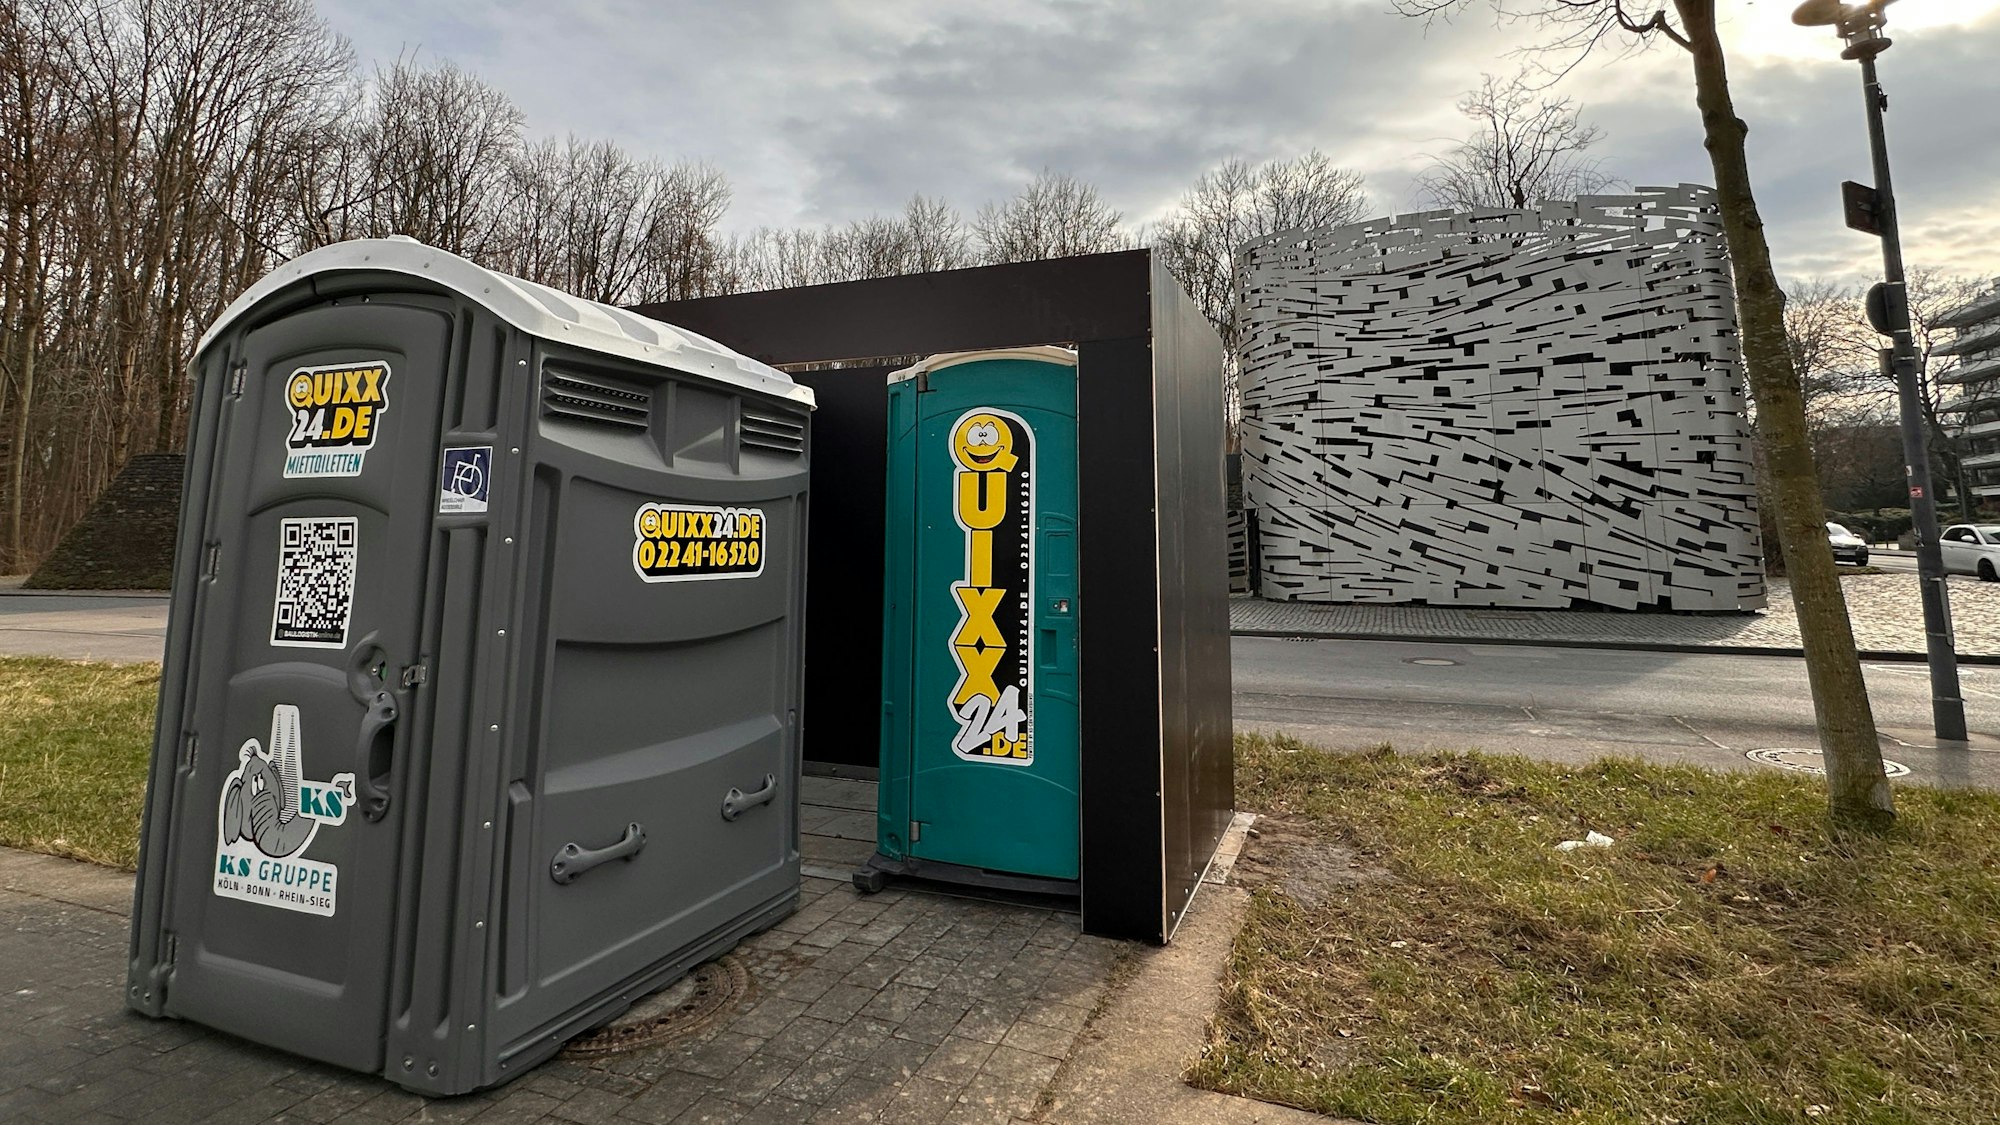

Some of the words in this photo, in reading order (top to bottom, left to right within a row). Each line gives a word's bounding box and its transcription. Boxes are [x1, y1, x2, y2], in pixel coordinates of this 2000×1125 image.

[291, 369, 382, 408] QUIXX
[291, 406, 372, 441] 24.DE
[286, 453, 363, 475] MIETTOILETTEN
[640, 509, 760, 539] QUIXX24.DE
[1020, 471, 1029, 569] 02241-16520
[639, 540, 760, 569] 02241-16520
[953, 413, 1019, 706] QUIXX
[1019, 592, 1028, 687] QUIXX24.DE
[301, 787, 342, 818] KS
[219, 854, 251, 877] KS
[259, 860, 332, 892] GRUPPE
[218, 878, 239, 891] KÖLN
[247, 884, 271, 897] BONN
[279, 890, 331, 908] RHEIN-SIEG
